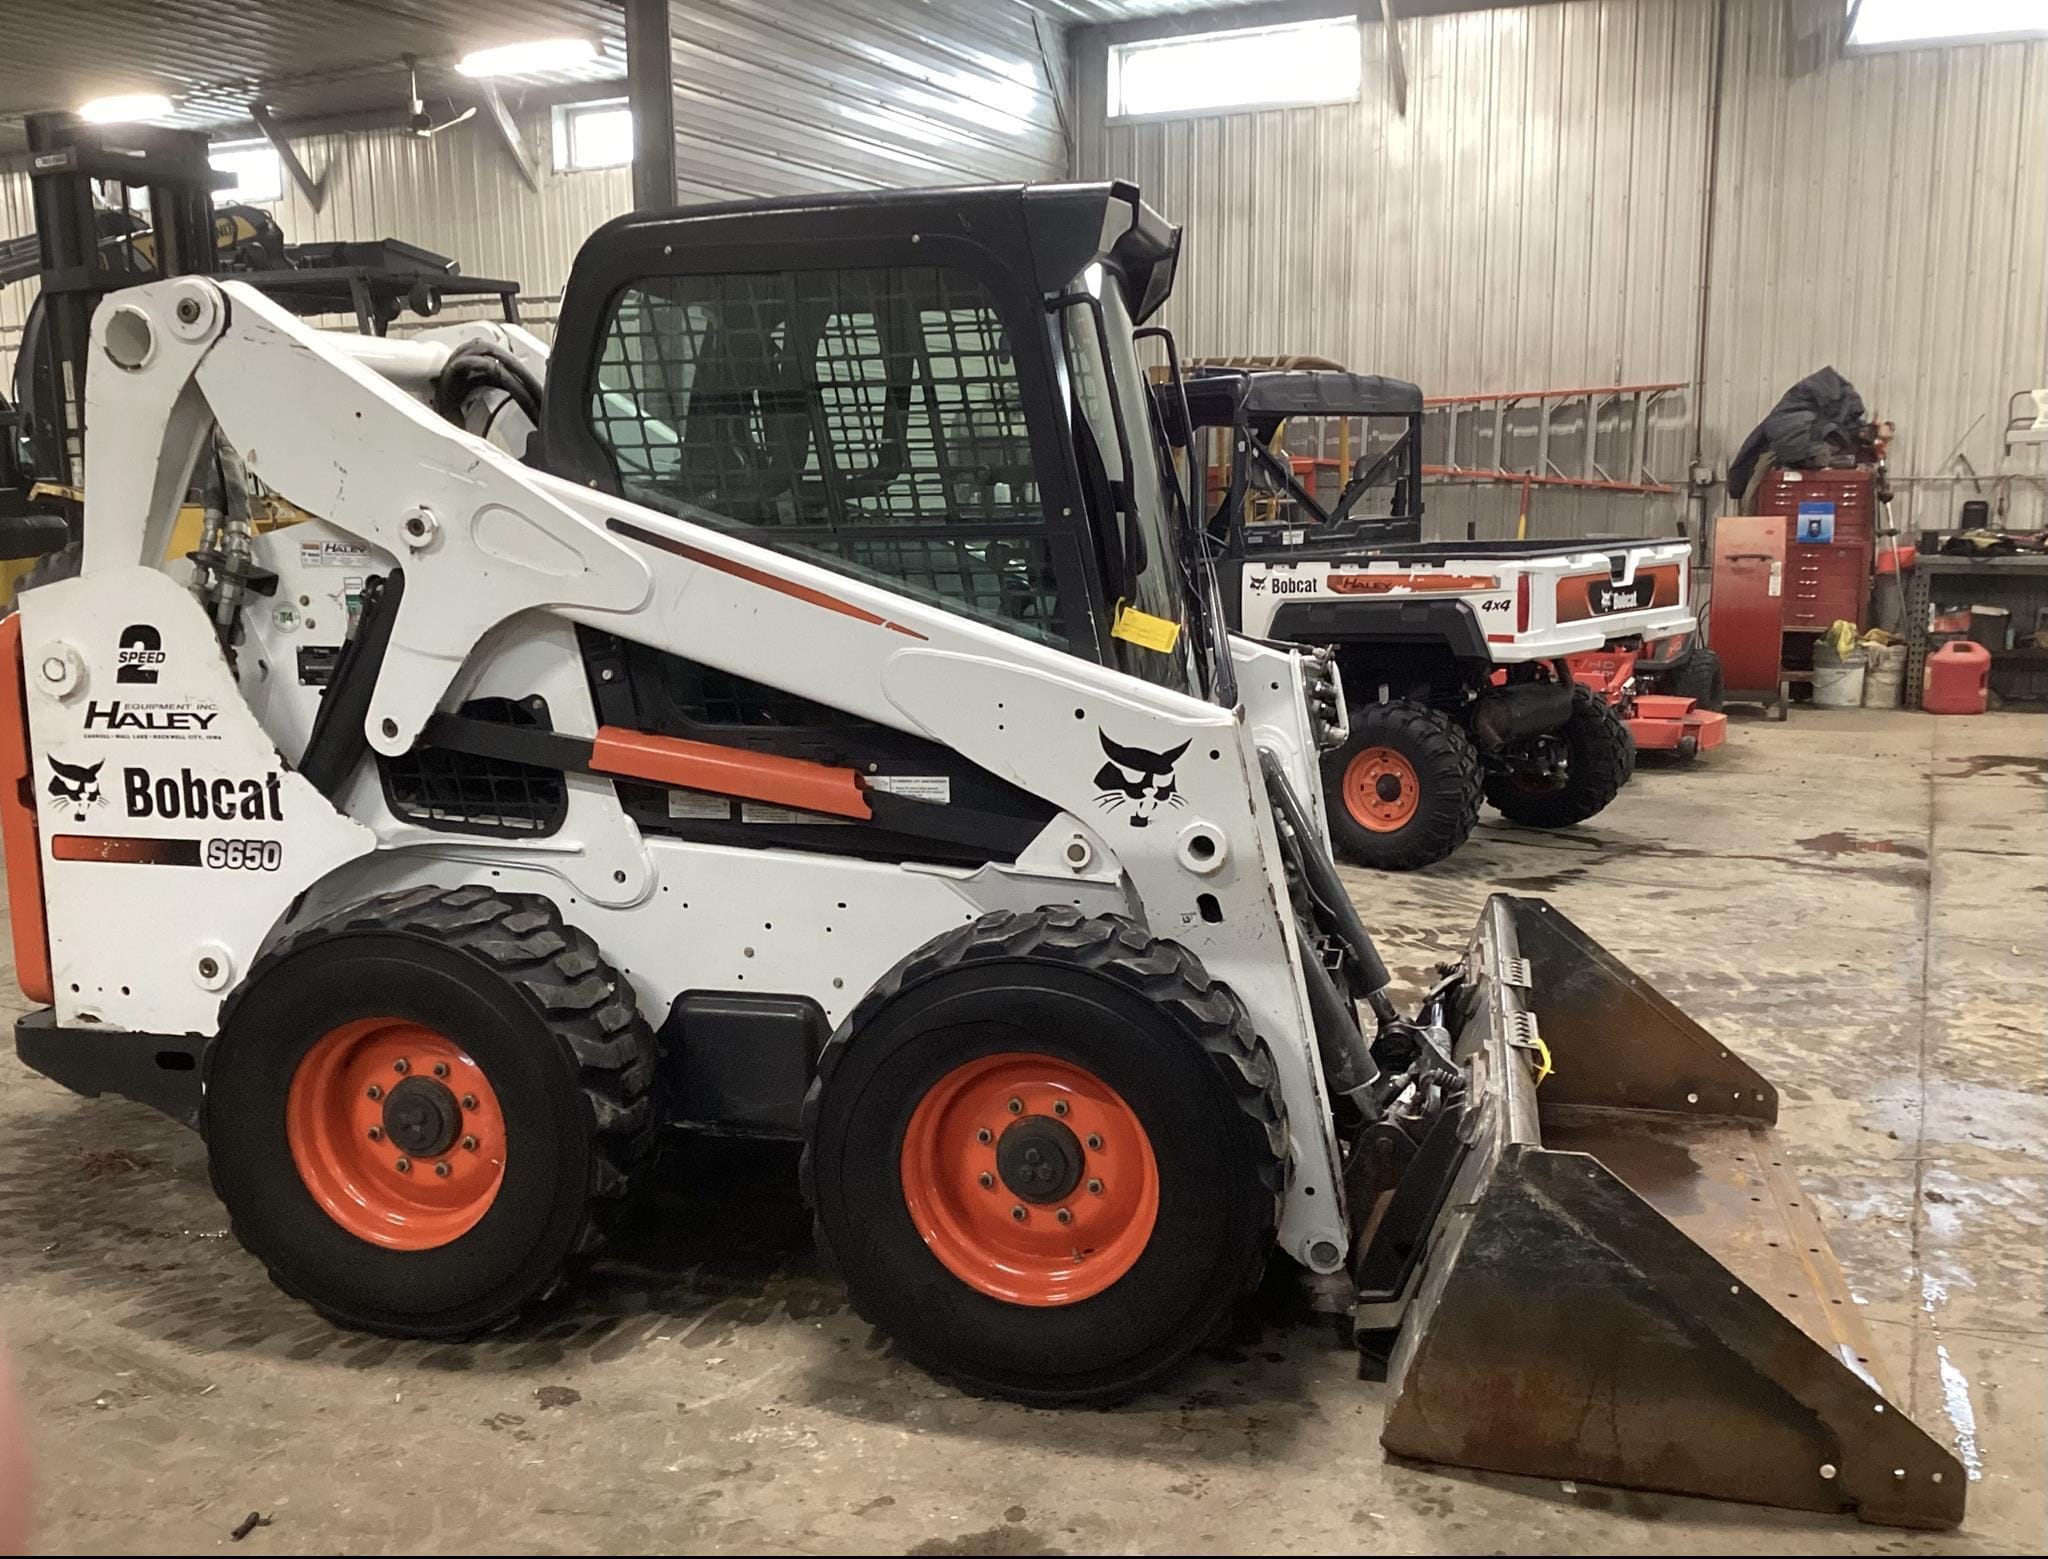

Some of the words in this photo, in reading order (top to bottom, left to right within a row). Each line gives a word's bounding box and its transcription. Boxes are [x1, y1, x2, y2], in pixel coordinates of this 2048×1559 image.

[1272, 578, 1317, 594] Bobcat
[1343, 577, 1392, 590] HALEY
[1481, 600, 1511, 613] 4x4
[1613, 590, 1637, 610] Bobcat
[116, 624, 162, 684] 2
[118, 651, 166, 664] SPEED
[84, 700, 218, 730] HALEY
[124, 703, 192, 711] EQUIPMENT
[123, 767, 284, 822] Bobcat
[207, 837, 283, 872] S650
